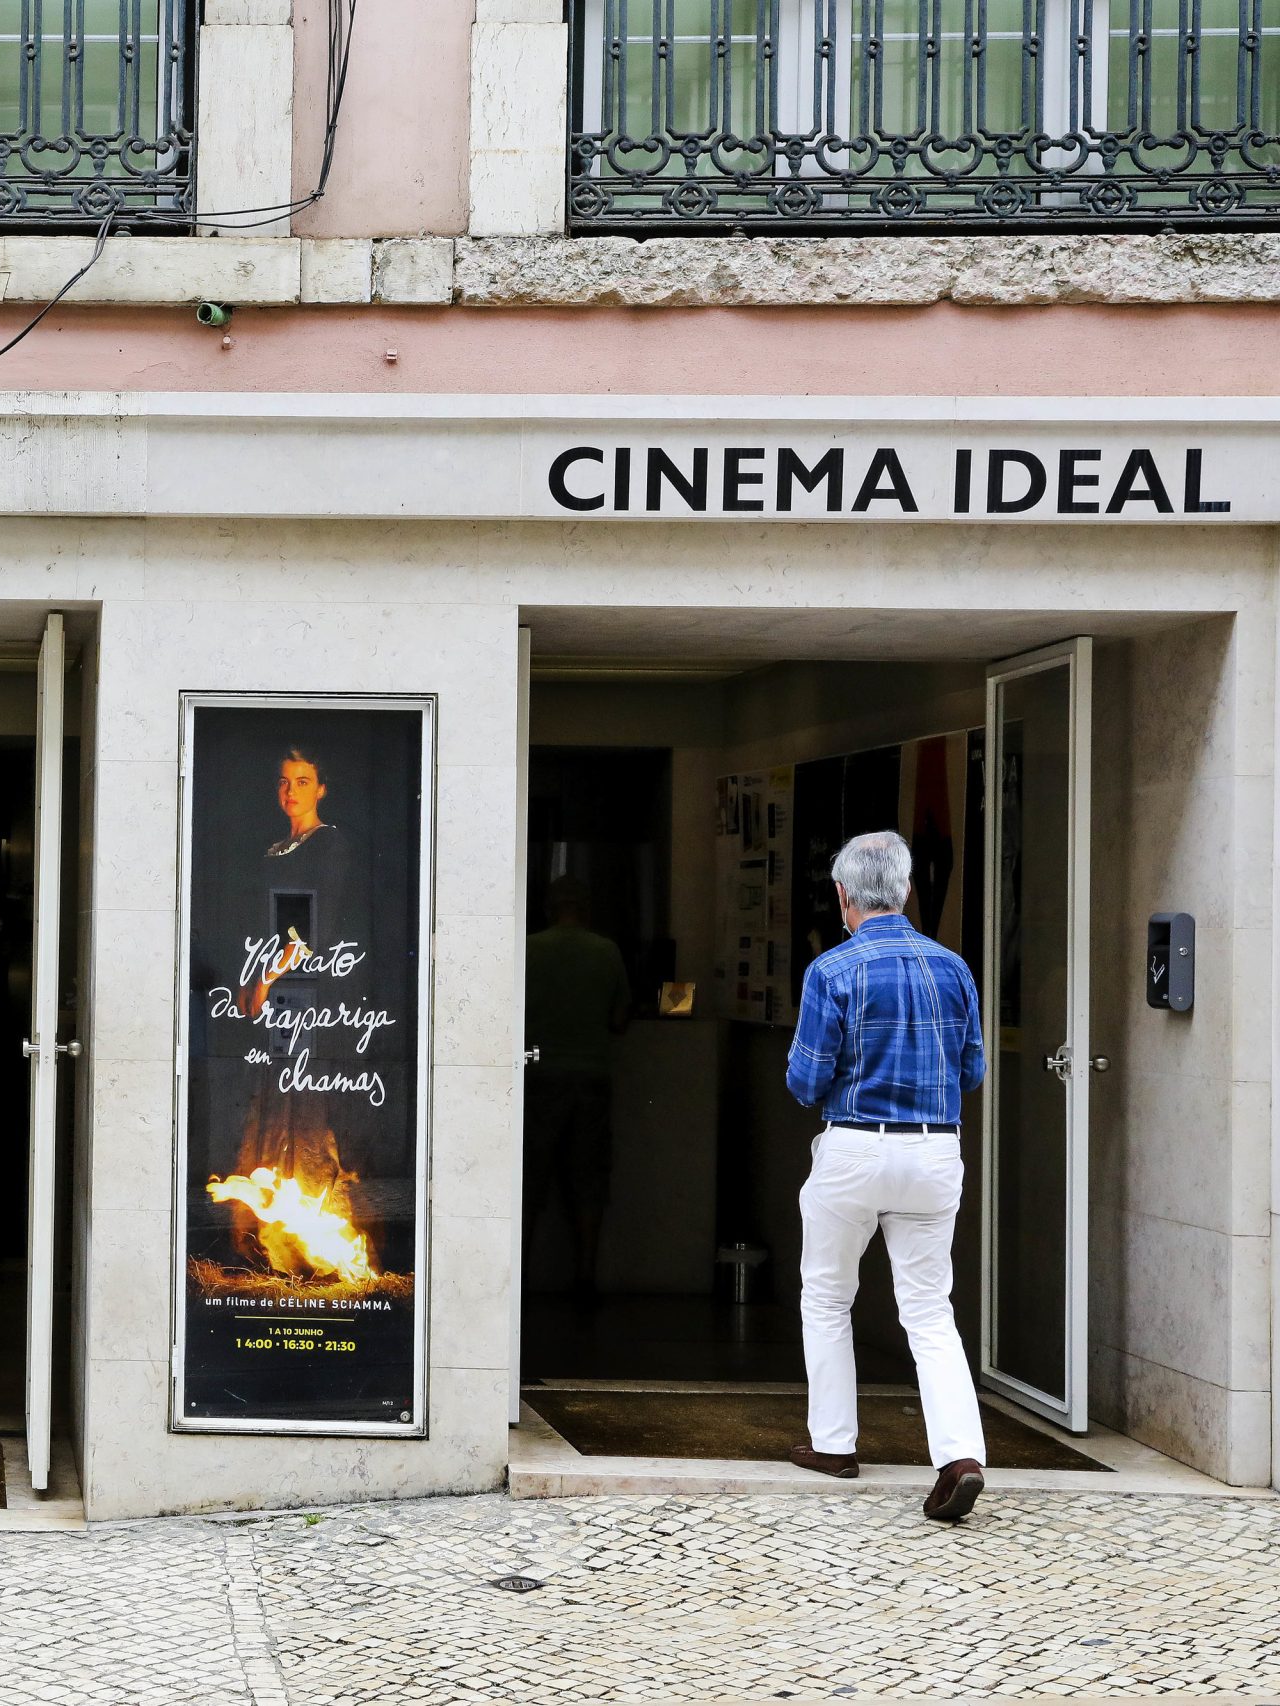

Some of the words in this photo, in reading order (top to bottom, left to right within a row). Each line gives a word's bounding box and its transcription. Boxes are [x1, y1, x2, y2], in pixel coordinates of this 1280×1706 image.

[548, 446, 920, 512] CINEMA
[953, 448, 1232, 514] IDEAL
[239, 933, 366, 987] Retrato
[208, 986, 246, 1018] da
[252, 996, 397, 1056] rapariga
[243, 1047, 272, 1066] em
[278, 1047, 386, 1107] chamas
[205, 1298, 222, 1306] um
[226, 1296, 256, 1306] filme
[260, 1297, 273, 1307] de
[279, 1295, 326, 1308] CÉLINE
[331, 1299, 391, 1311] SCIAMMA
[268, 1327, 273, 1335] 1
[283, 1328, 292, 1336] 10
[294, 1328, 324, 1337] JUNHO
[282, 1339, 314, 1350] 16:30
[324, 1340, 356, 1352] 21:30
